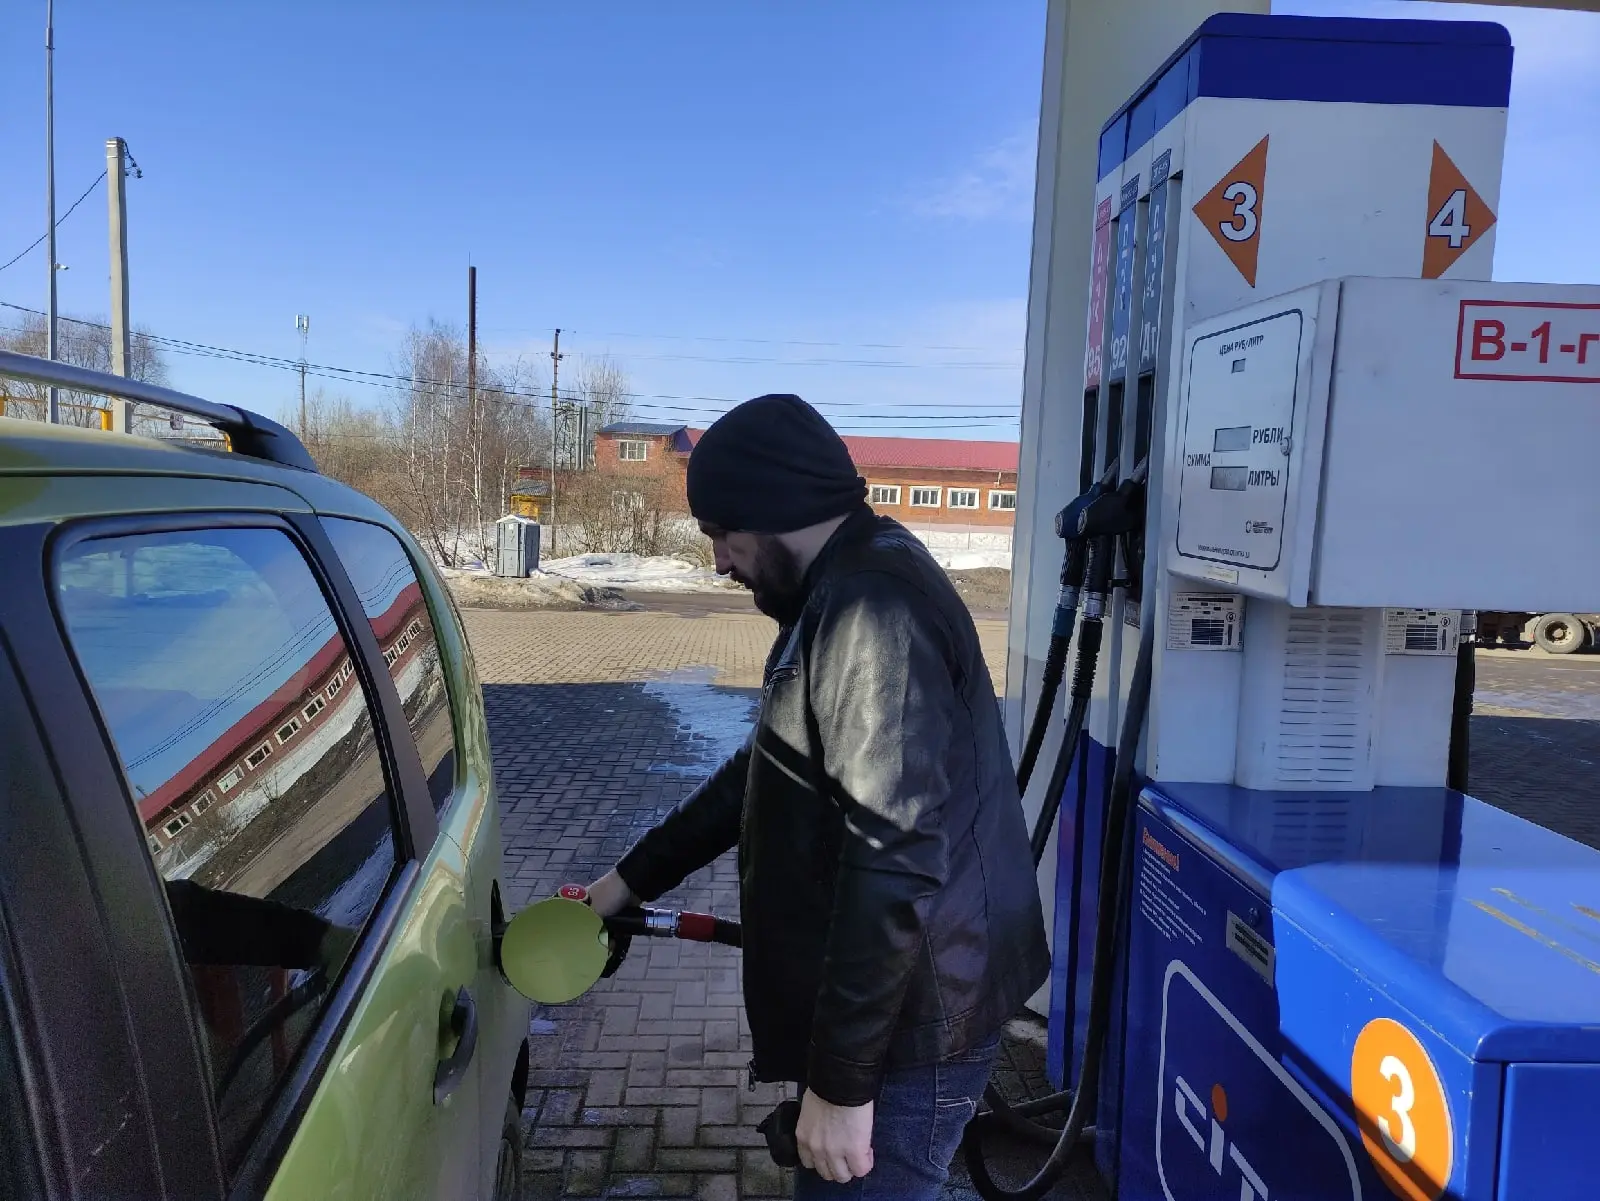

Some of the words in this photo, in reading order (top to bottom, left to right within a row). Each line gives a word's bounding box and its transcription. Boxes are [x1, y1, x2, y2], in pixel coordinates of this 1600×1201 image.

[1219, 181, 1258, 242] 3
[1428, 189, 1471, 248] 4
[1087, 344, 1101, 378] 95
[1112, 334, 1127, 370] 92
[1219, 342, 1234, 356] ЦЕНА
[1252, 426, 1284, 444] РУБЛИ
[1186, 453, 1211, 467] СУММА
[1247, 470, 1280, 487] ЛИТРЫ
[1377, 1055, 1416, 1163] 3
